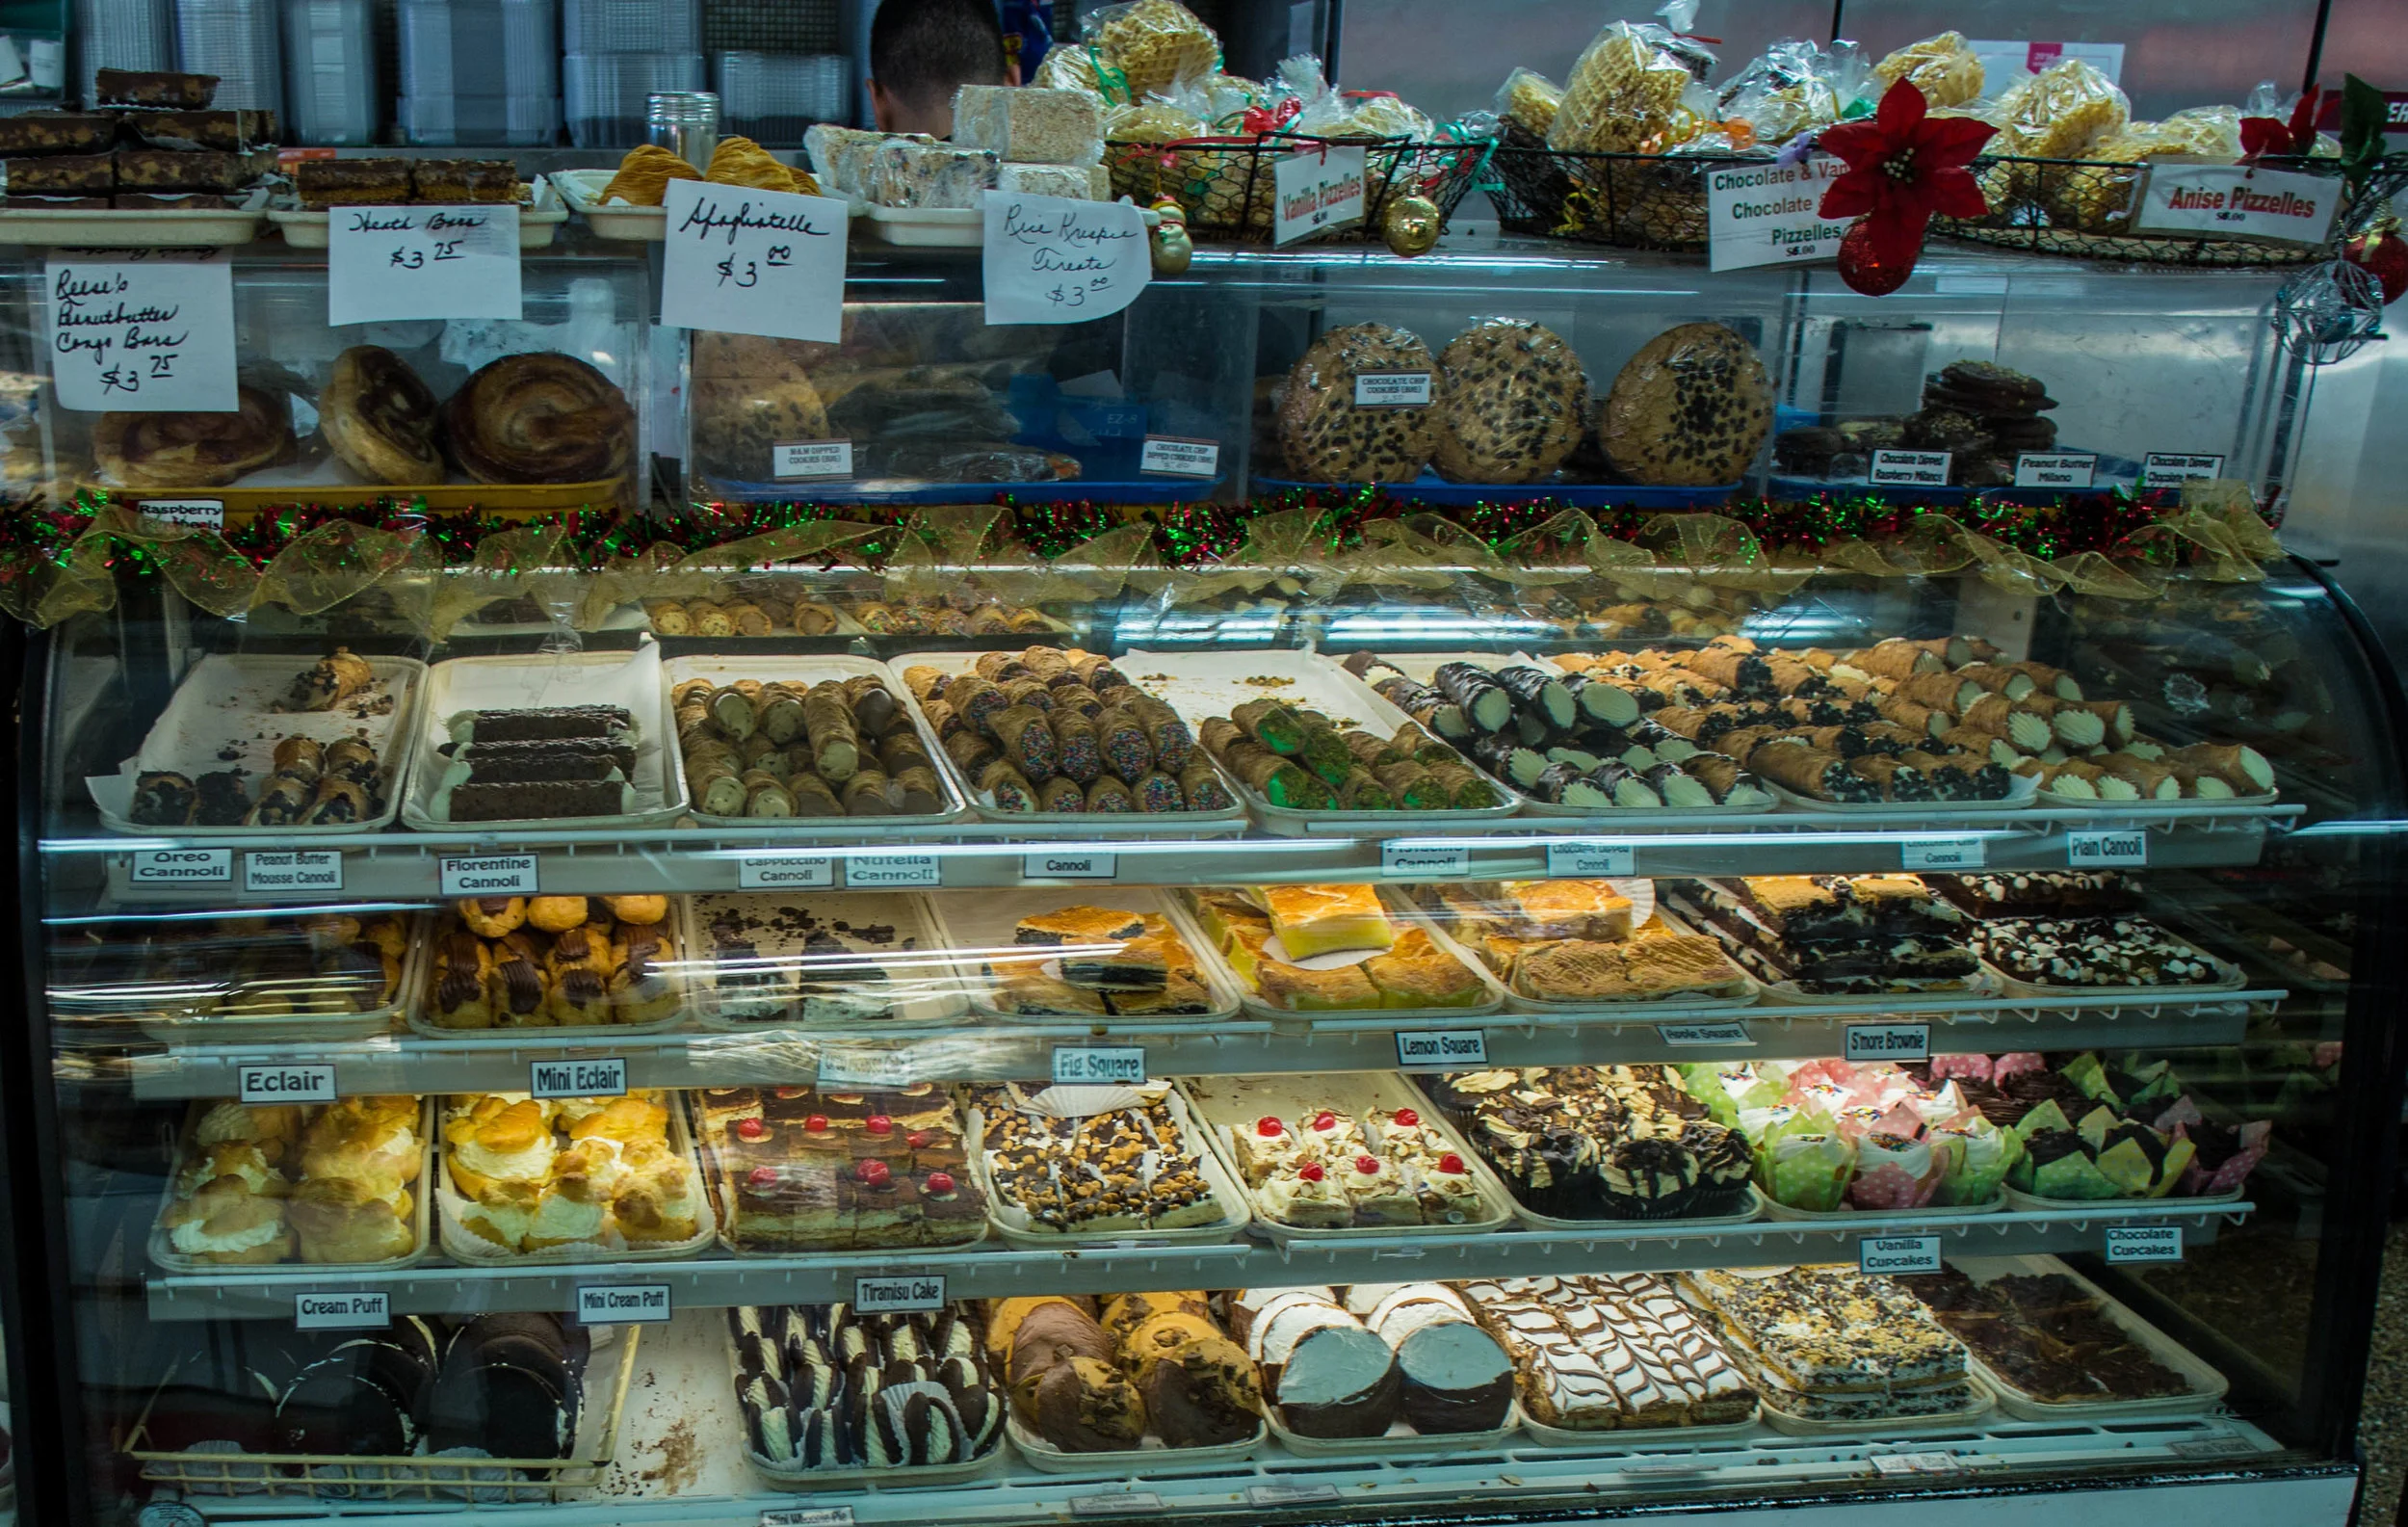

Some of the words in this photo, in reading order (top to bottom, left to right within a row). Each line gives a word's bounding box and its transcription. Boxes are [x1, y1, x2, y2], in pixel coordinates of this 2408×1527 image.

[1714, 168, 1795, 191] Chocolate
[1800, 164, 1812, 181] &
[1283, 186, 1317, 222] Vanilla
[1319, 172, 1361, 209] Pizzelles
[2168, 186, 2225, 209] Anise
[2229, 186, 2316, 219] Pizzelles
[1733, 197, 1813, 220] Chocolate
[349, 211, 415, 232] Heath
[1004, 204, 1053, 244] Rice
[1772, 224, 1842, 246] Pizzelles
[56, 269, 128, 305] Reese's
[123, 326, 189, 349] Bars
[1362, 377, 1407, 385] CHOCOLATE
[2021, 458, 2057, 468] Peanut
[2059, 459, 2093, 469] Butter
[2150, 456, 2186, 467] Chocolate
[2038, 472, 2073, 482] Milano
[140, 505, 222, 515] Raspberry
[2072, 836, 2100, 856] Plain
[2102, 836, 2142, 856] Cannoli
[154, 853, 211, 862] Oreo
[255, 854, 292, 865] Peanut
[296, 853, 330, 865] Butter
[1395, 856, 1456, 869] Cannoli
[1924, 852, 1962, 863] Cannoli
[140, 865, 225, 877] Cannoli
[446, 858, 531, 871] Florentine
[1046, 859, 1091, 871] Cannoli
[1576, 859, 1610, 870] Cannoli
[251, 872, 294, 884] Mousse
[297, 871, 336, 883] Cannoli
[458, 875, 520, 888] Cannoli
[760, 870, 813, 882] Cannoli
[852, 869, 934, 881] Cannoli
[1403, 1038, 1440, 1056] Lemon
[1442, 1036, 1481, 1056] Square
[1851, 1032, 1884, 1050] S'more
[1886, 1030, 1924, 1050] Brownie
[1061, 1052, 1084, 1077] Fig
[1087, 1052, 1139, 1078] Square
[246, 1071, 325, 1092] Eclair
[537, 1067, 571, 1091] Mini
[576, 1066, 621, 1090] Eclair
[2108, 1229, 2174, 1240] Chocolate
[1875, 1239, 1923, 1251] Vanilla
[2112, 1245, 2175, 1256] Cupcakes
[1867, 1255, 1932, 1267] Cupcakes
[862, 1282, 909, 1302] Tiramisu
[912, 1278, 939, 1300] Cake
[301, 1298, 348, 1315] Cream
[353, 1298, 383, 1314] Puff
[584, 1292, 605, 1308] Mini
[608, 1293, 641, 1308] Cream
[642, 1292, 665, 1307] Puff
